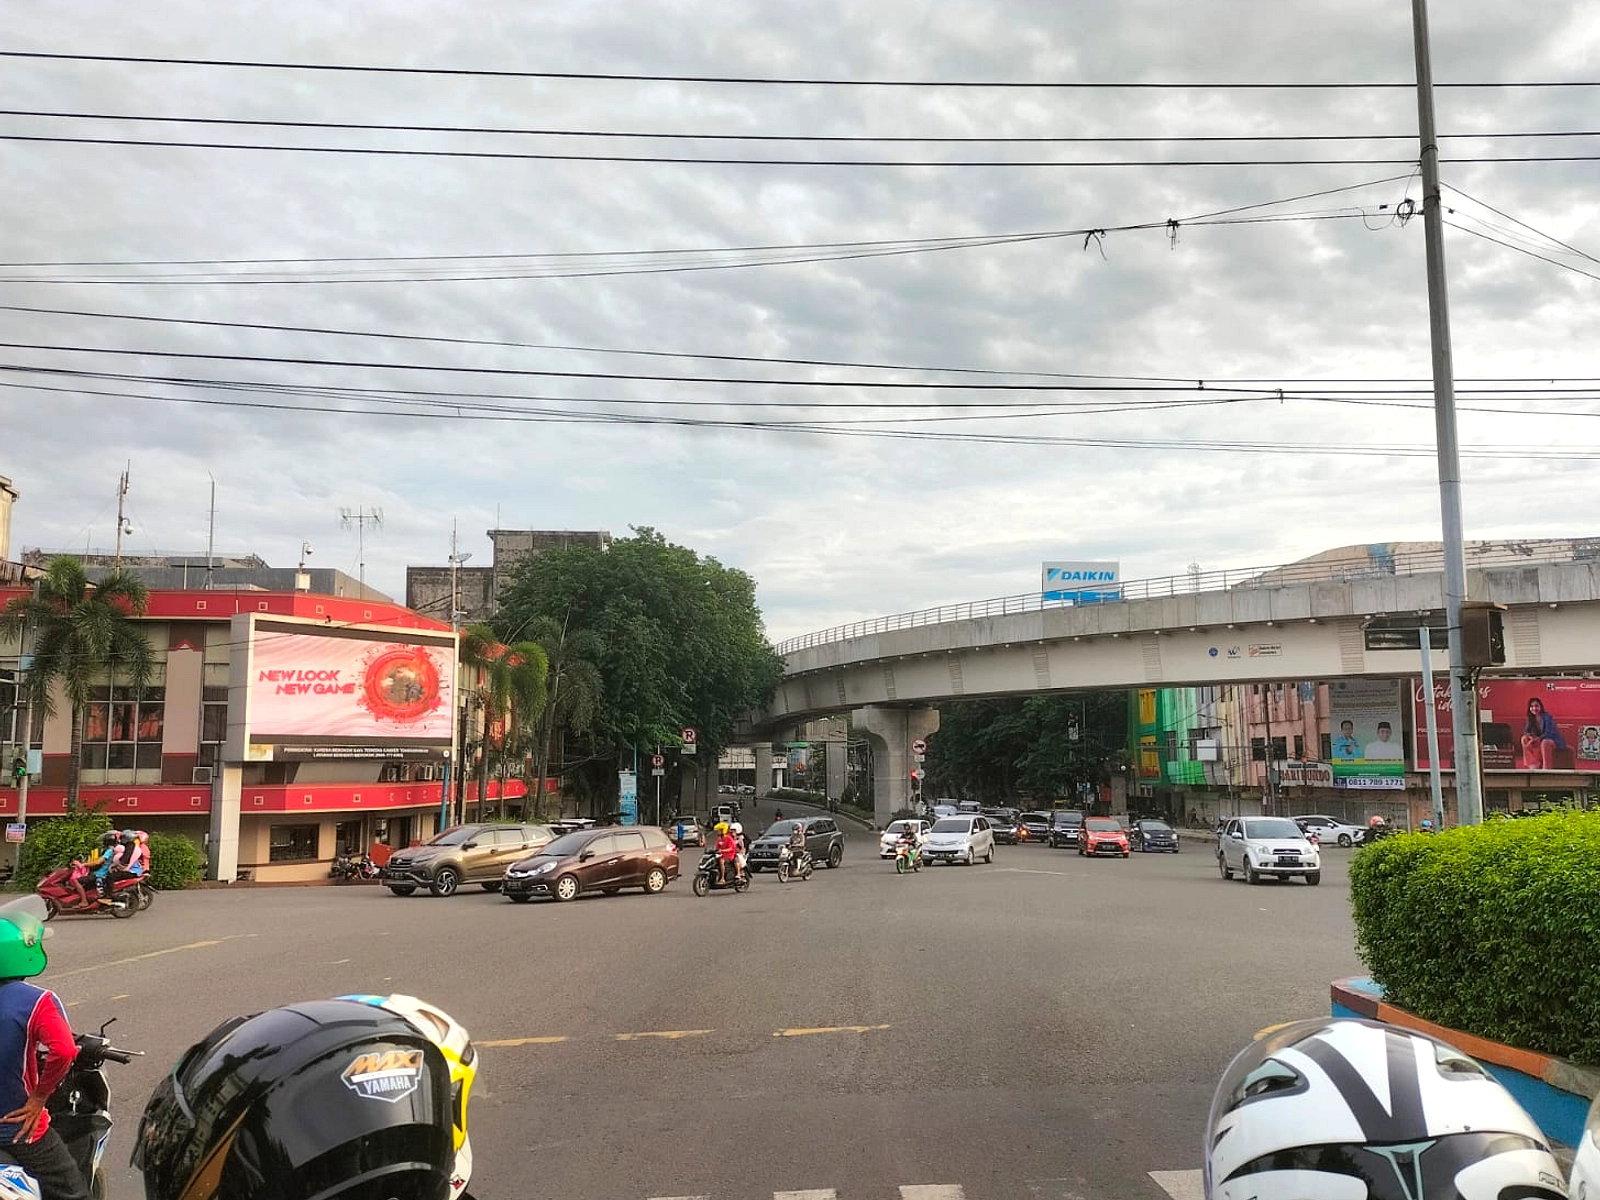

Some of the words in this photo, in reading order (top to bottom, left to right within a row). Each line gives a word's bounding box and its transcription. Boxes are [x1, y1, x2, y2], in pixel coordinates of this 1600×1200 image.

[1061, 571, 1115, 581] DAIKIN
[258, 669, 296, 682] NEW
[296, 669, 341, 682] LOOK
[275, 684, 312, 696] NEW
[313, 683, 356, 695] GAME
[363, 1076, 412, 1095] YAMAHA
